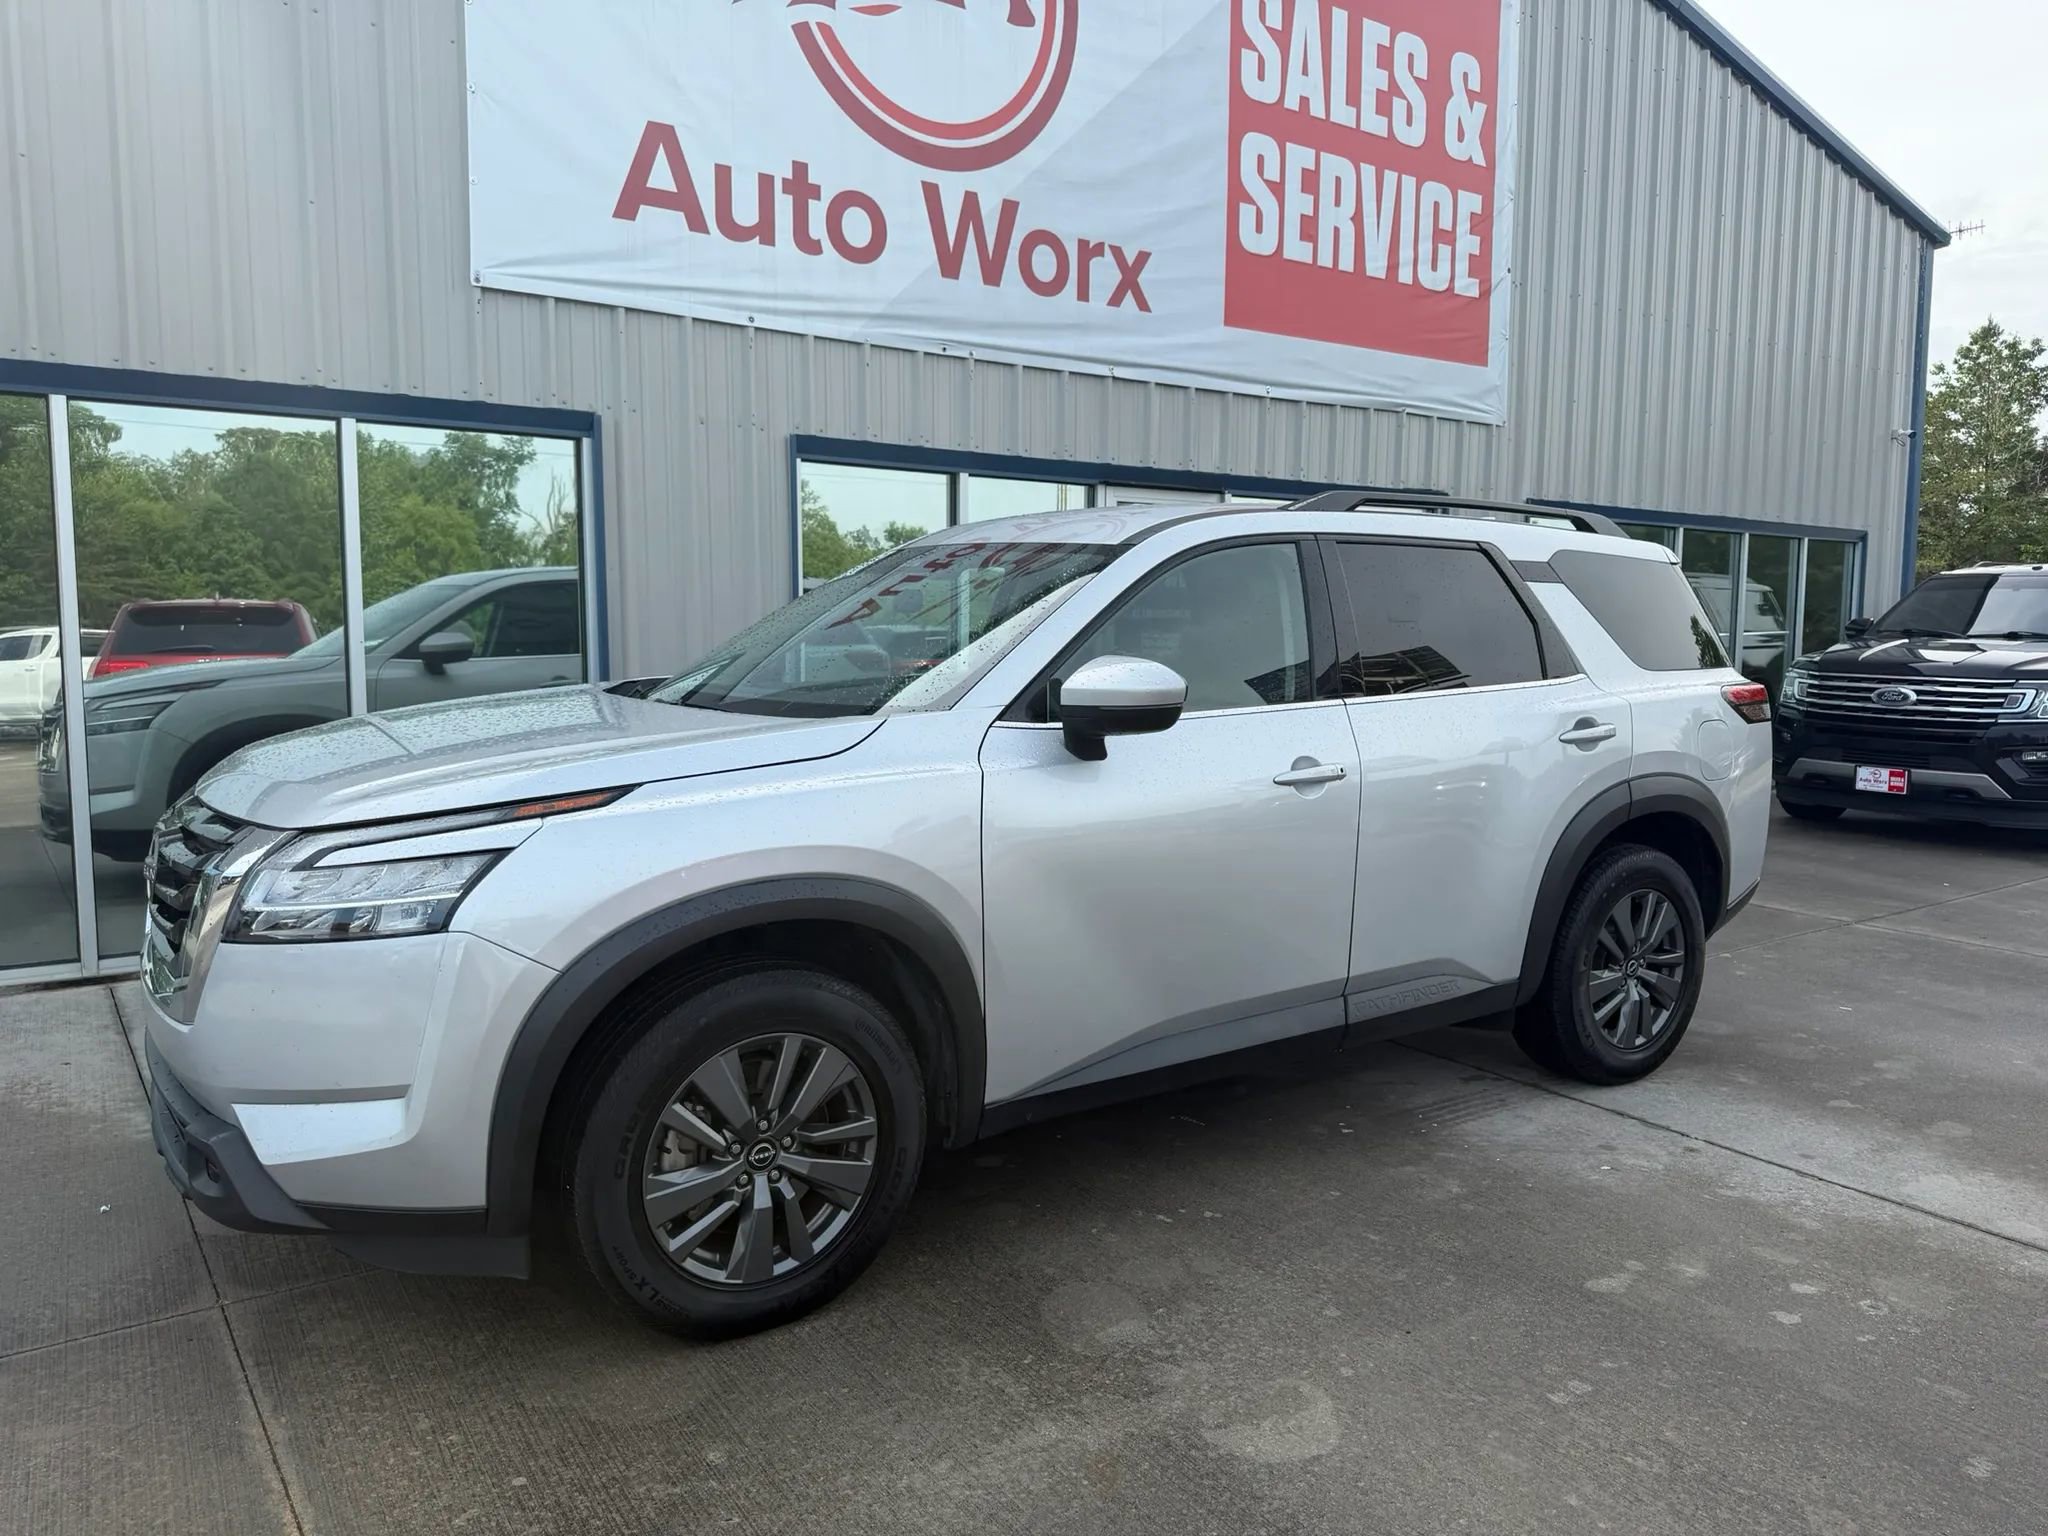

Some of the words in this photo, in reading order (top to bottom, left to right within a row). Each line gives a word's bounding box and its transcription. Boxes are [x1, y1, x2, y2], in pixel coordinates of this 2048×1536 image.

[1240, 0, 1428, 148] SALES
[1444, 51, 1488, 167] &
[612, 120, 888, 265] Auto
[920, 180, 1152, 313] Worx
[1238, 131, 1483, 298] SERVICE
[1352, 979, 1461, 1018] PATHFINDER
